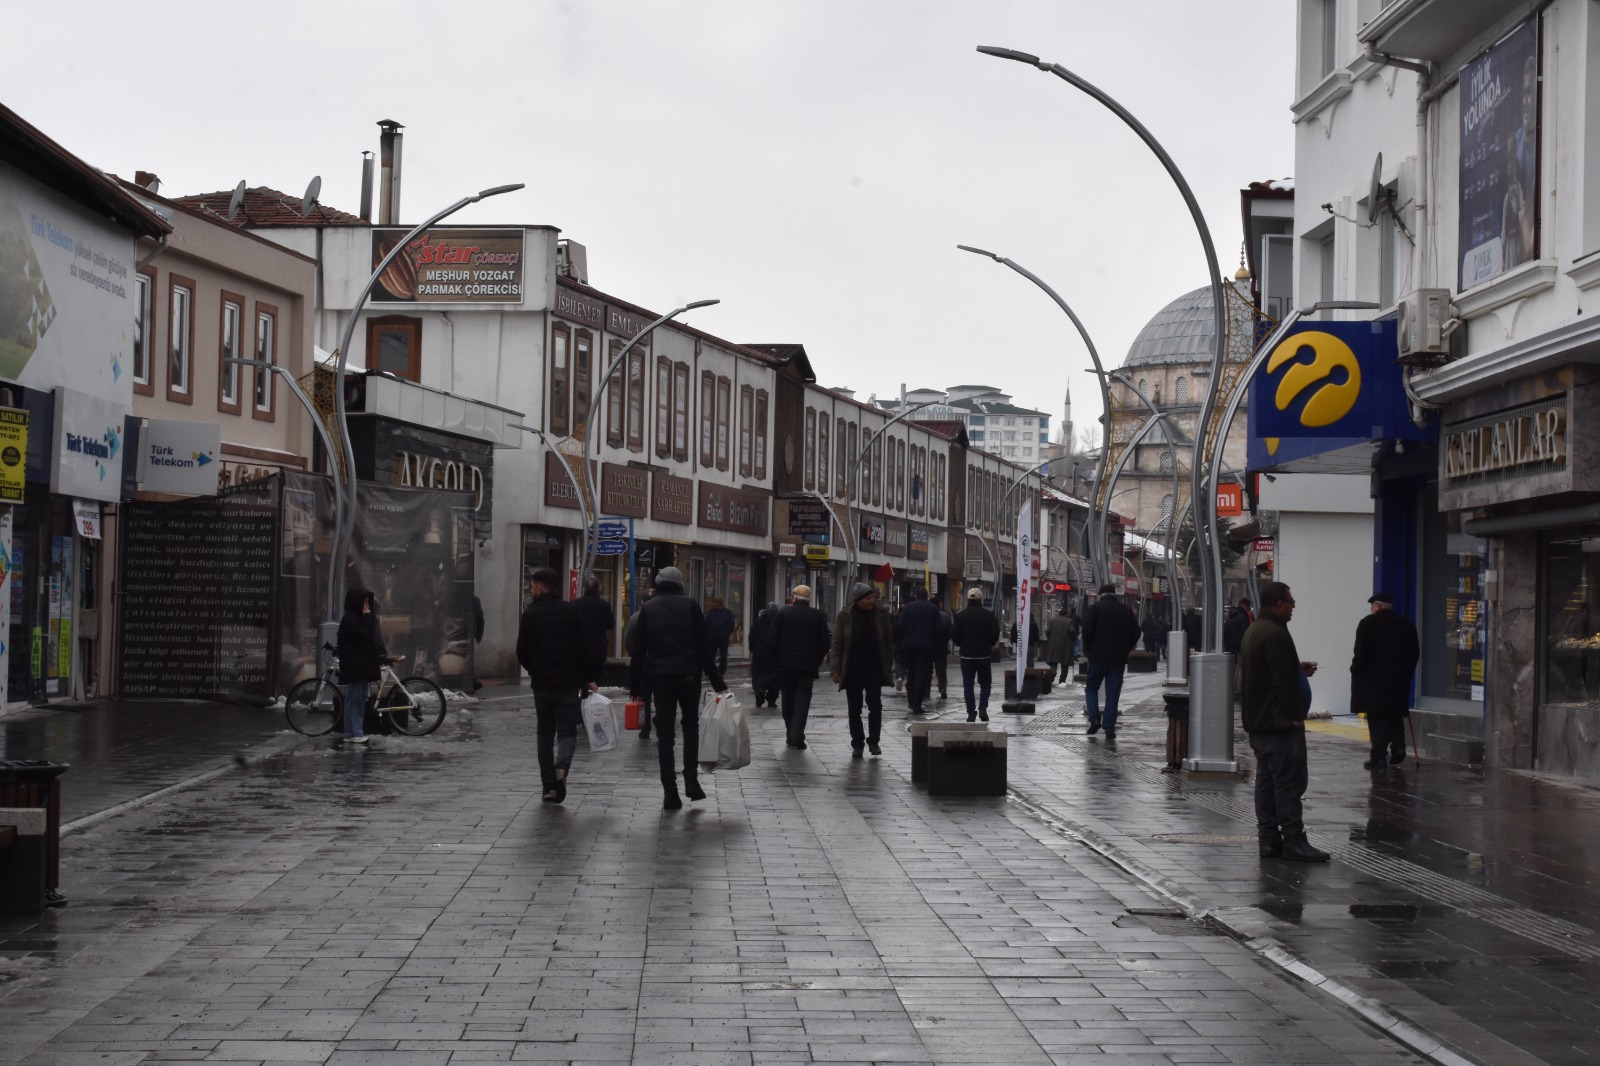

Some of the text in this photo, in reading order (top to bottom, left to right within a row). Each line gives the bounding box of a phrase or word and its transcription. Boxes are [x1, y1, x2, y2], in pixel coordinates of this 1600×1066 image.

[1471, 56, 1491, 102] İYİLİK
[1464, 75, 1501, 136] YOLUNDA
[417, 242, 480, 265] star
[426, 270, 516, 282] MEŞHUR YOZGAT
[418, 282, 522, 297] PARMAK ÇÖREKCİSİ
[150, 445, 174, 456] Türk
[150, 456, 194, 468] Telekom
